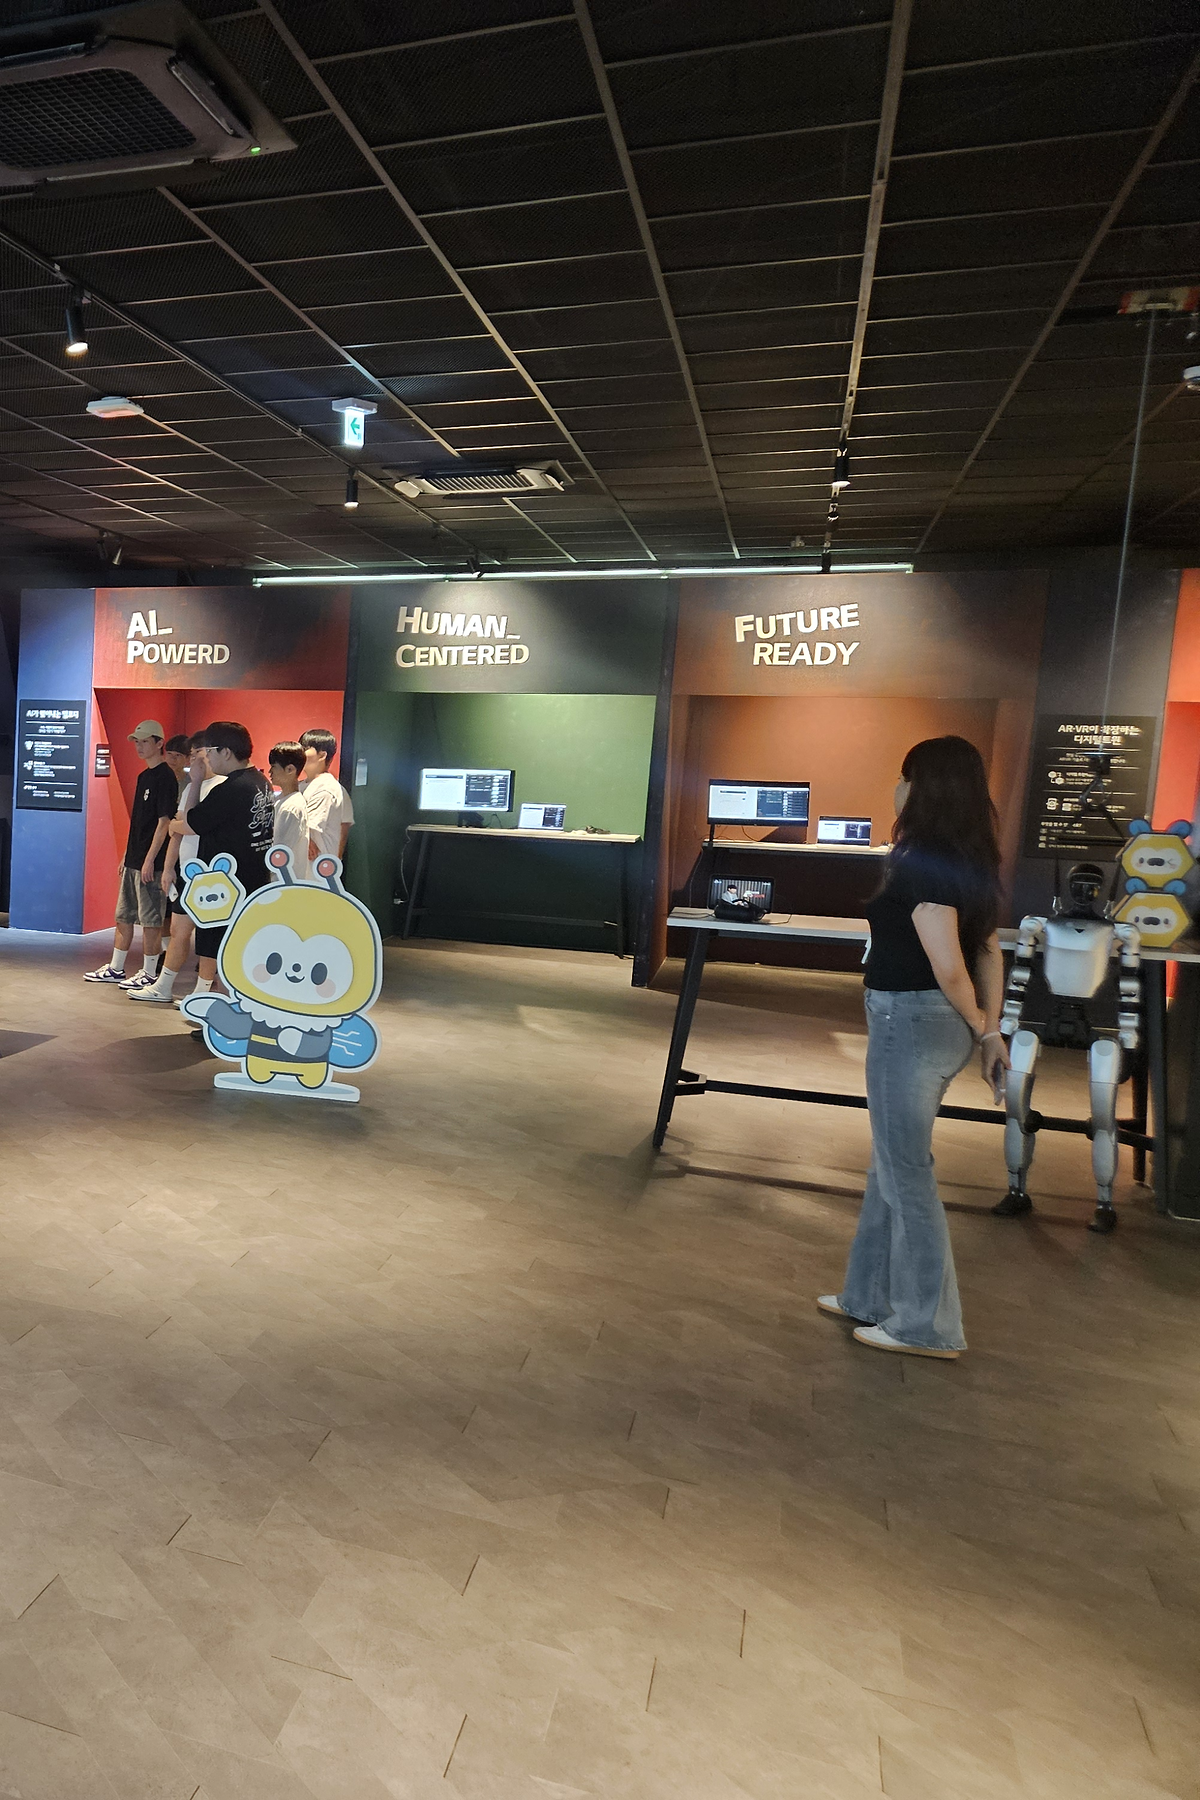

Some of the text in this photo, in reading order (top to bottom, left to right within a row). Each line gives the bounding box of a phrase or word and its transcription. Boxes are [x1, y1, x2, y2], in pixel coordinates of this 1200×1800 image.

[735, 603, 860, 643] FUTURE
[127, 640, 231, 664] POWERD
[396, 643, 530, 668] CENTERED
[753, 642, 860, 666] READY
